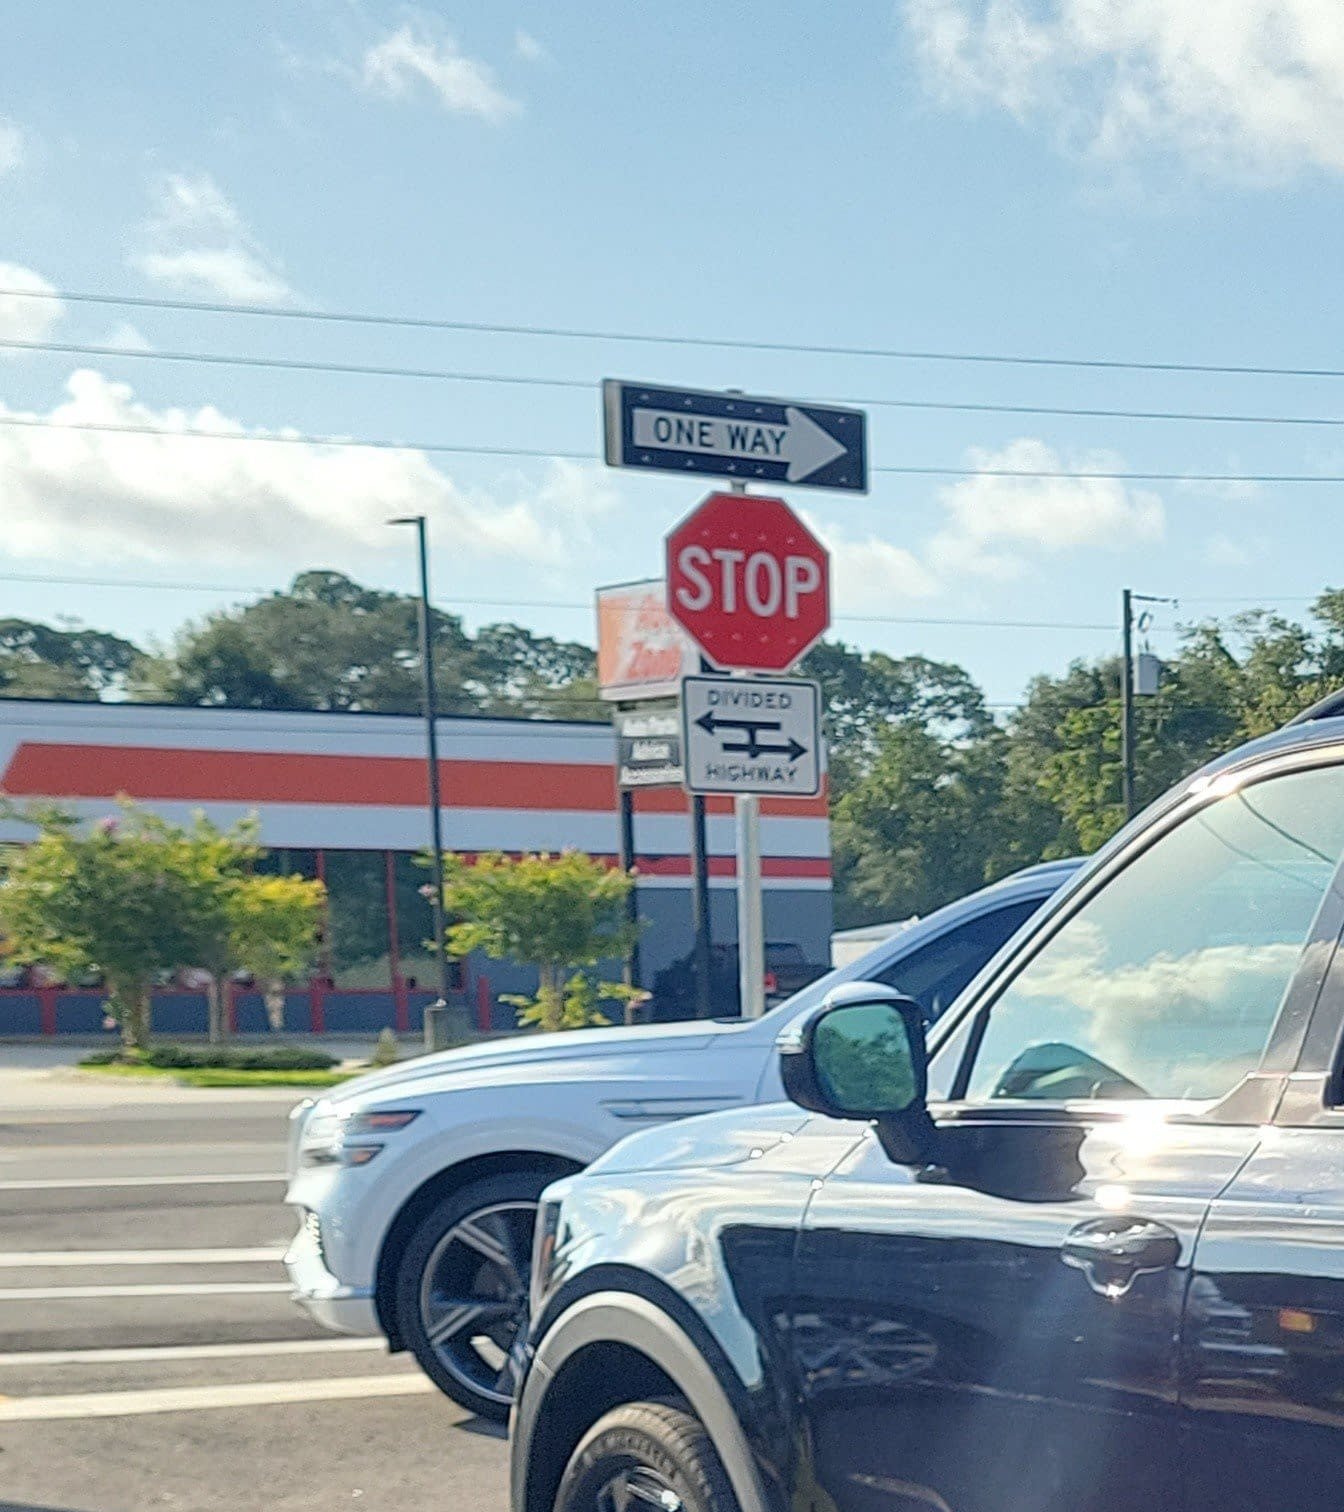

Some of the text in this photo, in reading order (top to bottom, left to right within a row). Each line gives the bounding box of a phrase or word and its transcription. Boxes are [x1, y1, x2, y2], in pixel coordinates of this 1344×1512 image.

[653, 416, 786, 456] ONE WAY
[675, 544, 821, 620] STOP
[707, 689, 792, 709] DIVIDED
[705, 763, 797, 782] HIGHWAY
